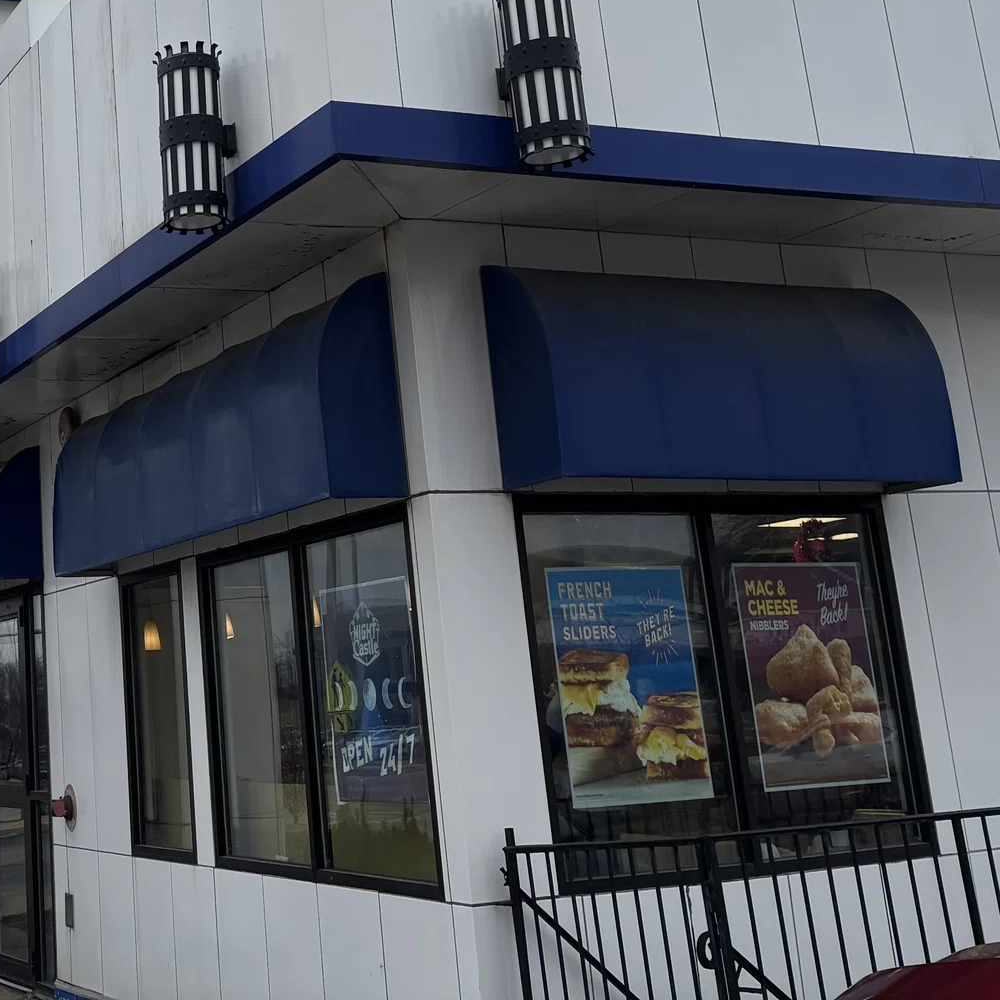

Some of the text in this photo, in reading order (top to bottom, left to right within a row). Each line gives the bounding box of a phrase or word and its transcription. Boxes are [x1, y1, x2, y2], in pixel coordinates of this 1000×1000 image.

[557, 581, 612, 600] FRENCH
[744, 580, 786, 597] MAC &
[560, 603, 605, 622] TOAST
[747, 599, 799, 616] CHEESE
[820, 603, 848, 626] Back!
[636, 605, 676, 636] THEY'RE
[750, 619, 789, 632] NIBBLERS
[353, 622, 377, 640] NIGHT
[563, 625, 617, 641] SLIDERS
[644, 623, 672, 648] BACK!
[353, 639, 379, 657] Castle
[341, 733, 415, 776] OPEN 24/7
